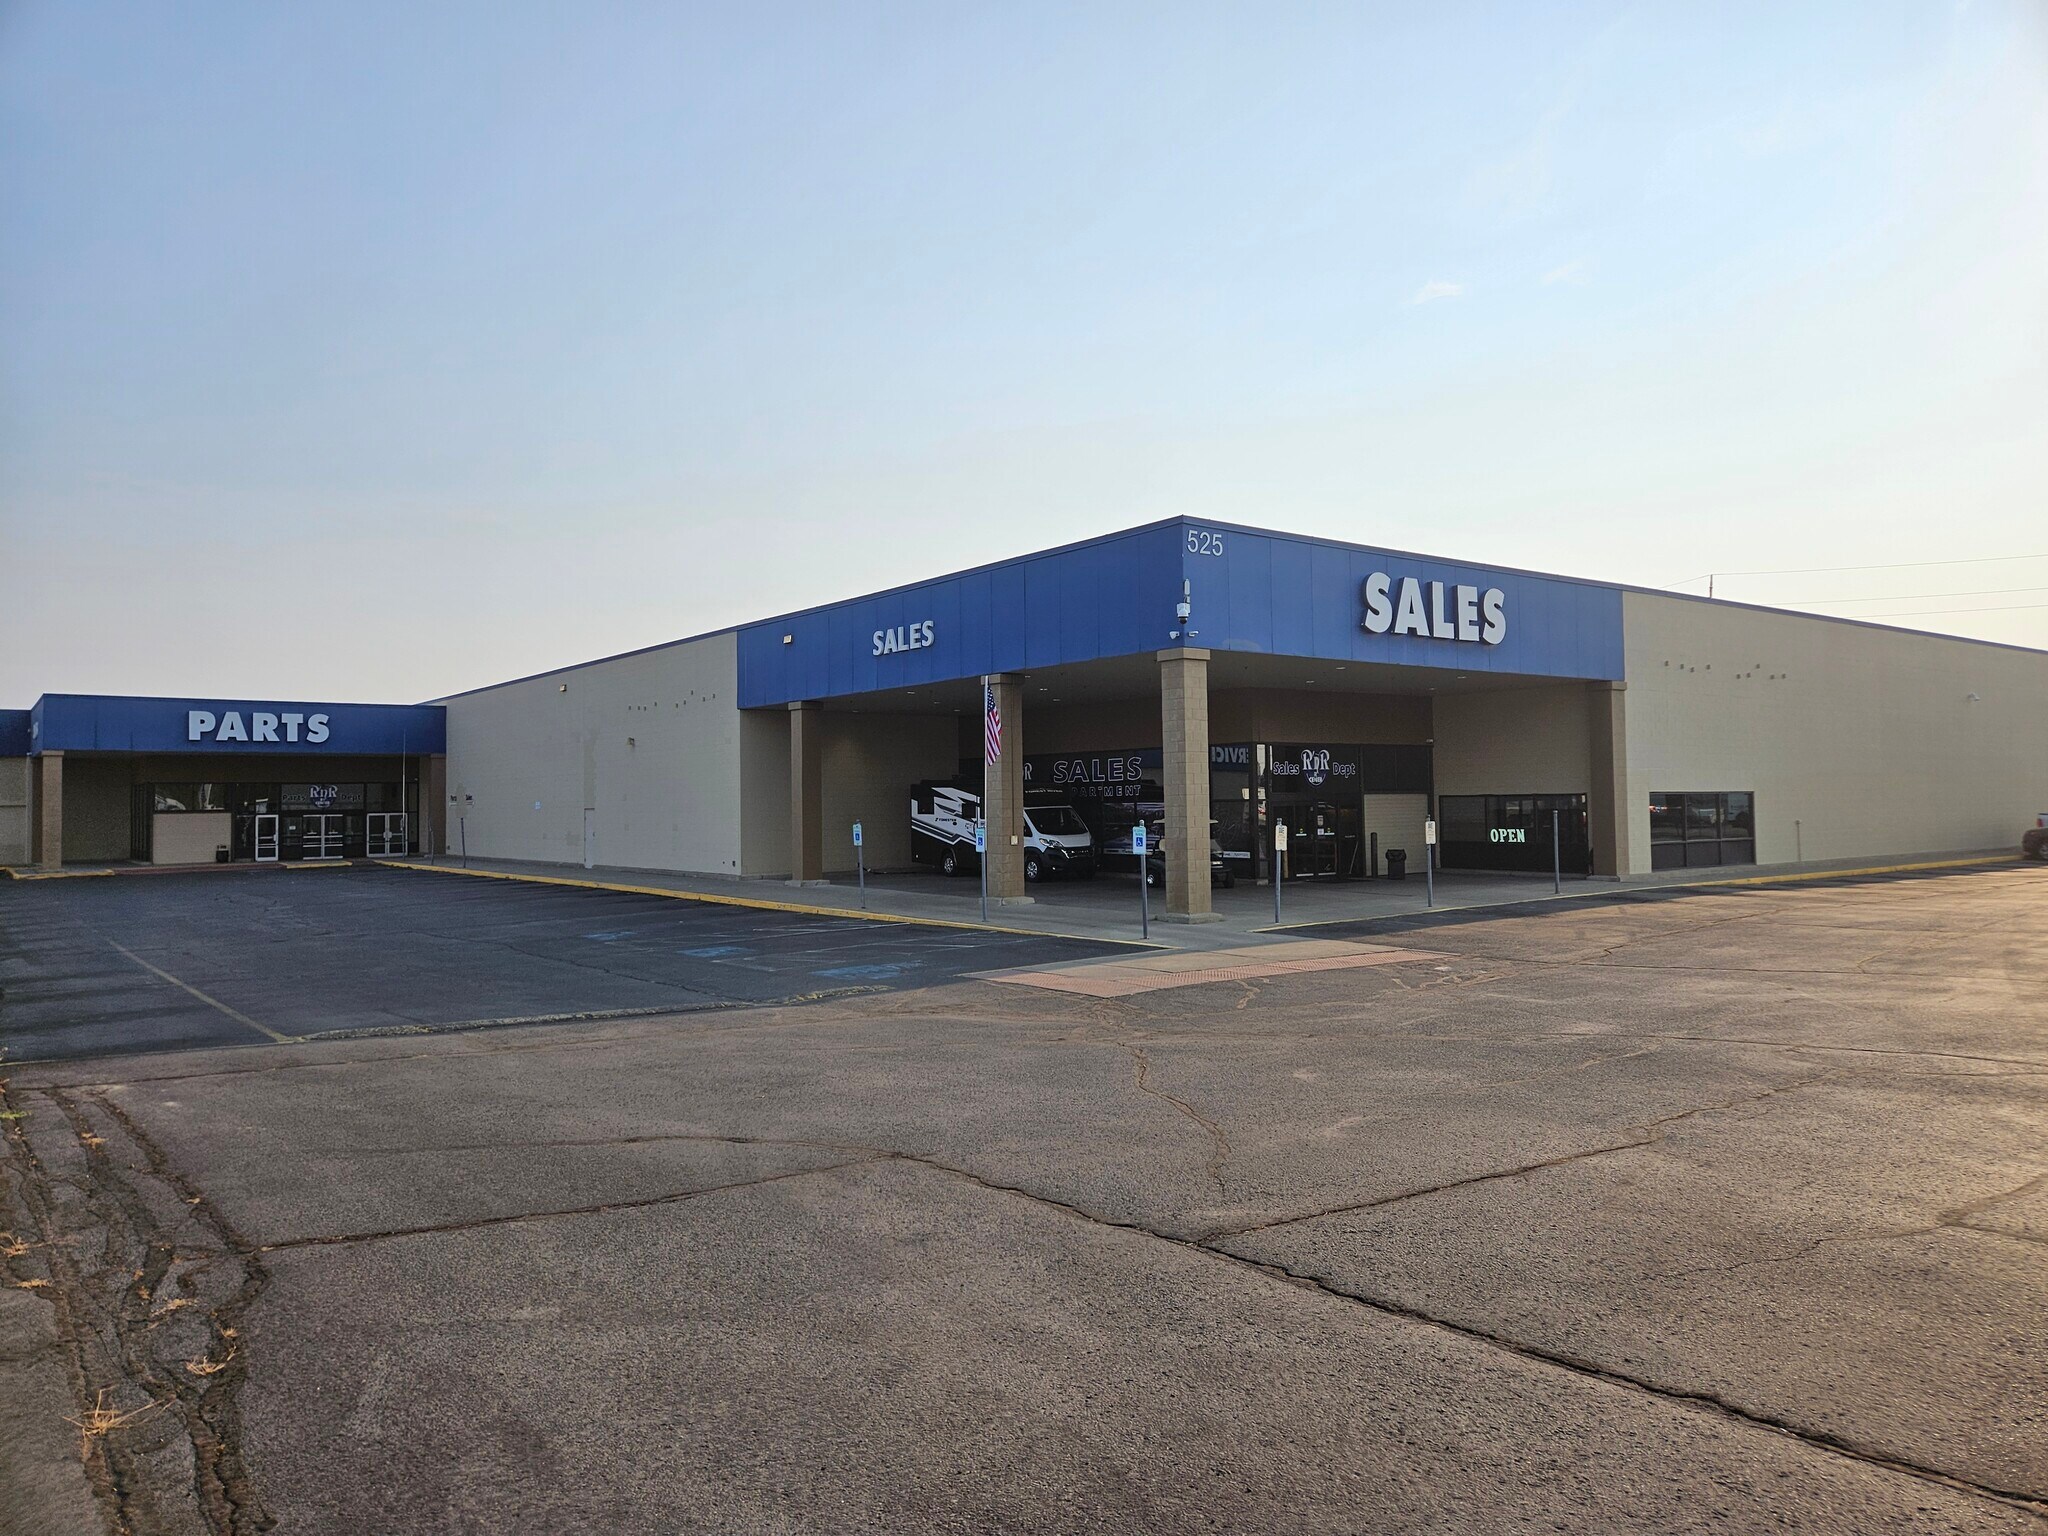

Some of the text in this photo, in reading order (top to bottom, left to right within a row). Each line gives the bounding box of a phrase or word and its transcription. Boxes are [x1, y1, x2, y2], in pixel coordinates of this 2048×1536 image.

[1187, 529, 1223, 557] 525
[1363, 571, 1507, 645] SALES
[872, 620, 935, 656] SALES
[188, 710, 330, 743] PARTS
[1053, 756, 1142, 783] SALES
[1273, 761, 1300, 775] Sales
[1332, 762, 1356, 778] Dept
[1490, 828, 1526, 843] OPEN
